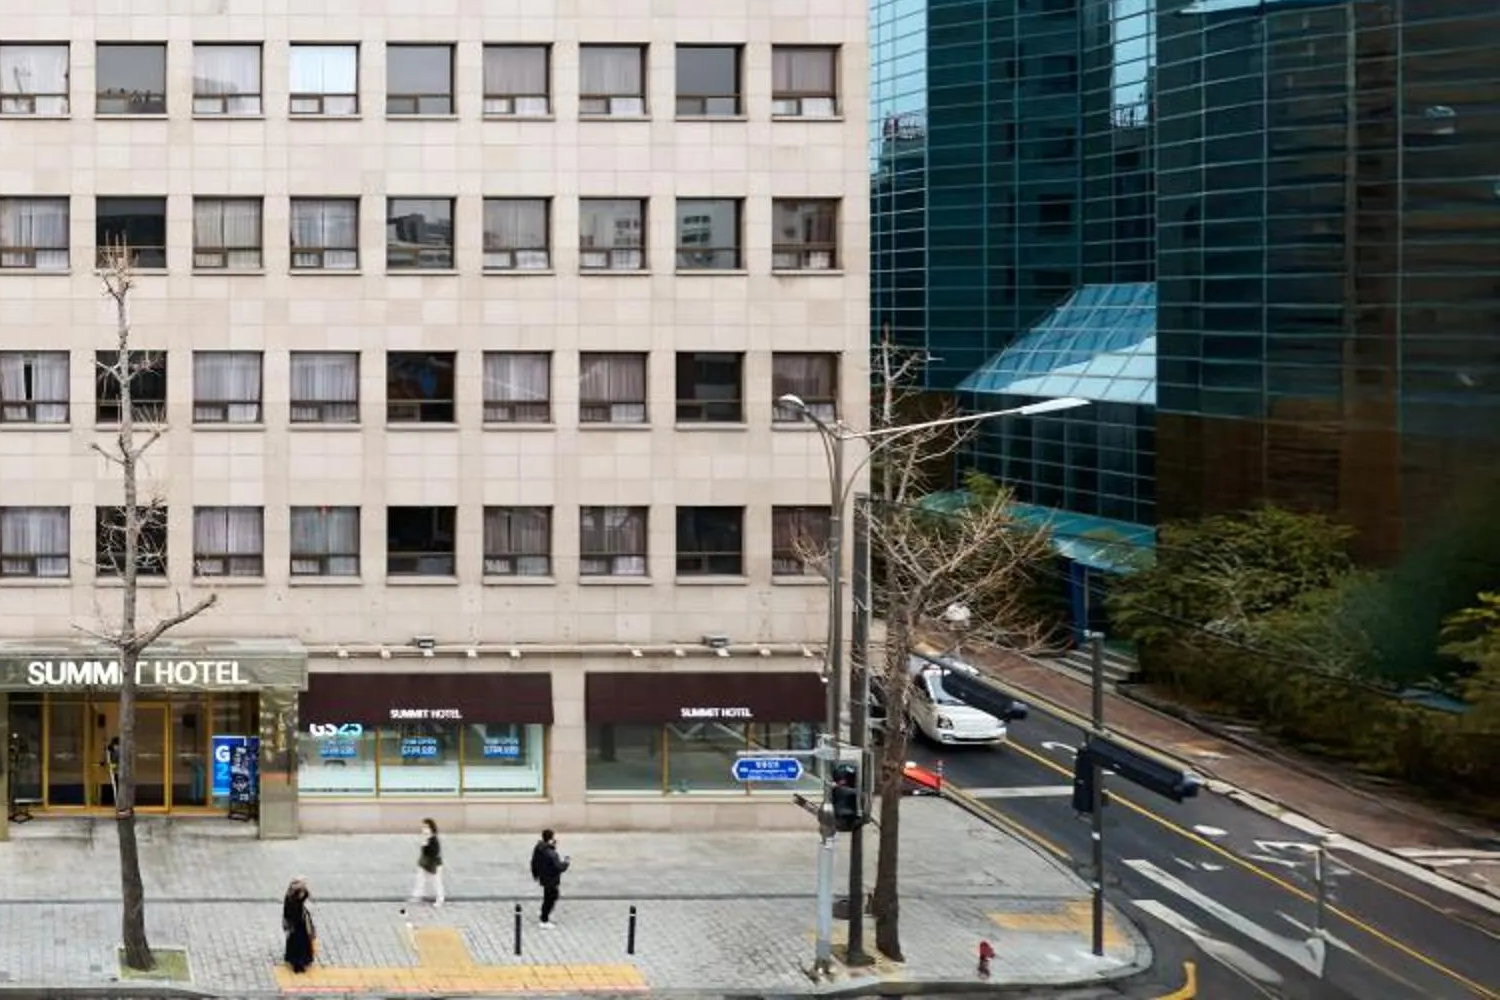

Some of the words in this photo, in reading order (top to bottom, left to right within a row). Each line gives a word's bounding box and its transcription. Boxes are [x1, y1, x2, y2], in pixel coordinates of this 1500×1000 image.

[154, 661, 248, 686] HOTEL
[389, 709, 429, 719] SUMMIT
[430, 709, 463, 719] HOTEL
[680, 707, 720, 718] SUMMIT
[721, 707, 754, 718] HOTEL
